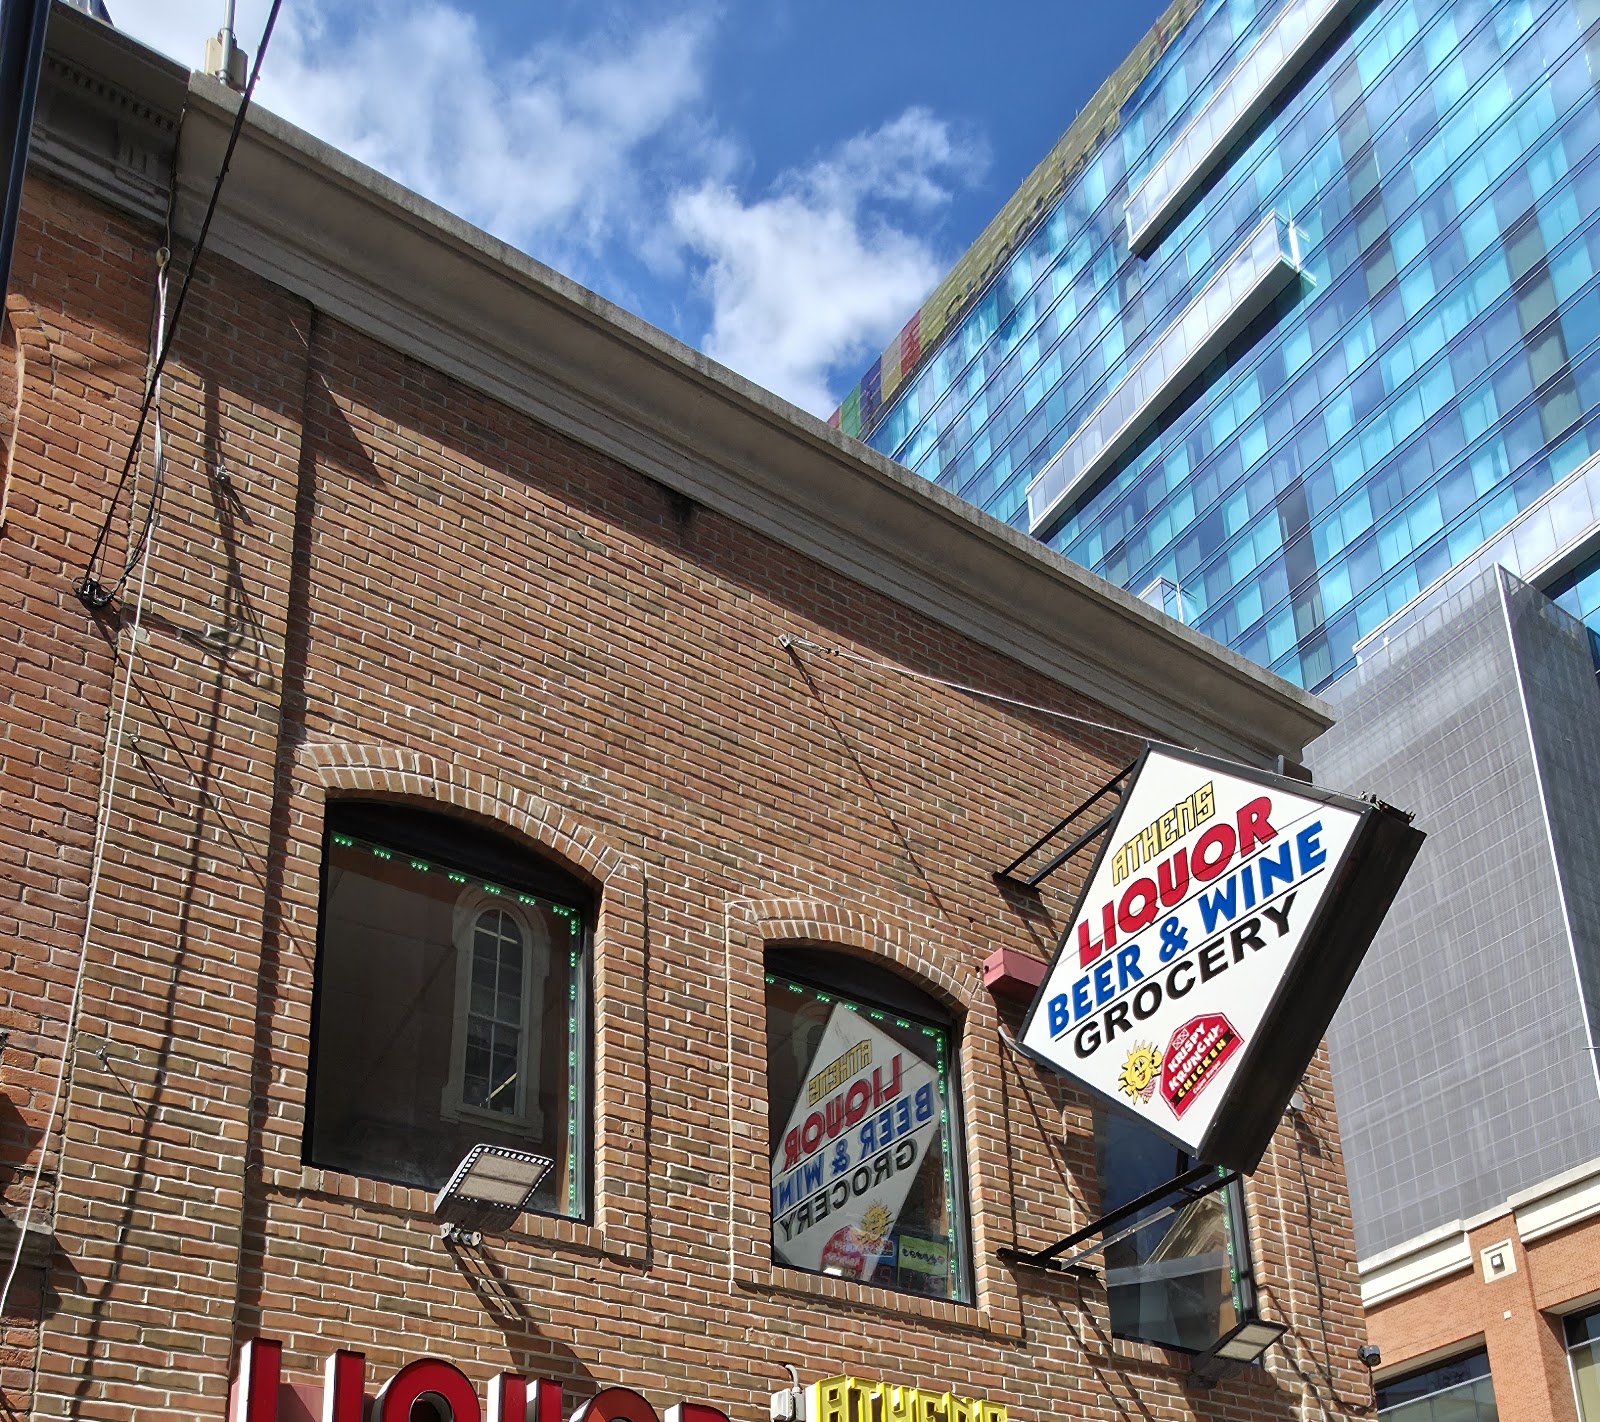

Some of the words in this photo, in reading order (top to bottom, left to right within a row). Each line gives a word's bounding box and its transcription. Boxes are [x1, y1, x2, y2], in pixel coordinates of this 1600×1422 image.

[1077, 796, 1279, 969] LIQUOR
[1112, 780, 1215, 887] ATHENS
[1047, 943, 1141, 1039] BEER
[1159, 916, 1189, 963] &
[1197, 820, 1328, 935] WINE
[1073, 891, 1299, 1059] GROCERY
[1168, 1022, 1205, 1072] KRISPY
[1168, 1025, 1220, 1091] KRUNCHY
[1178, 1039, 1227, 1098] CHICKEN
